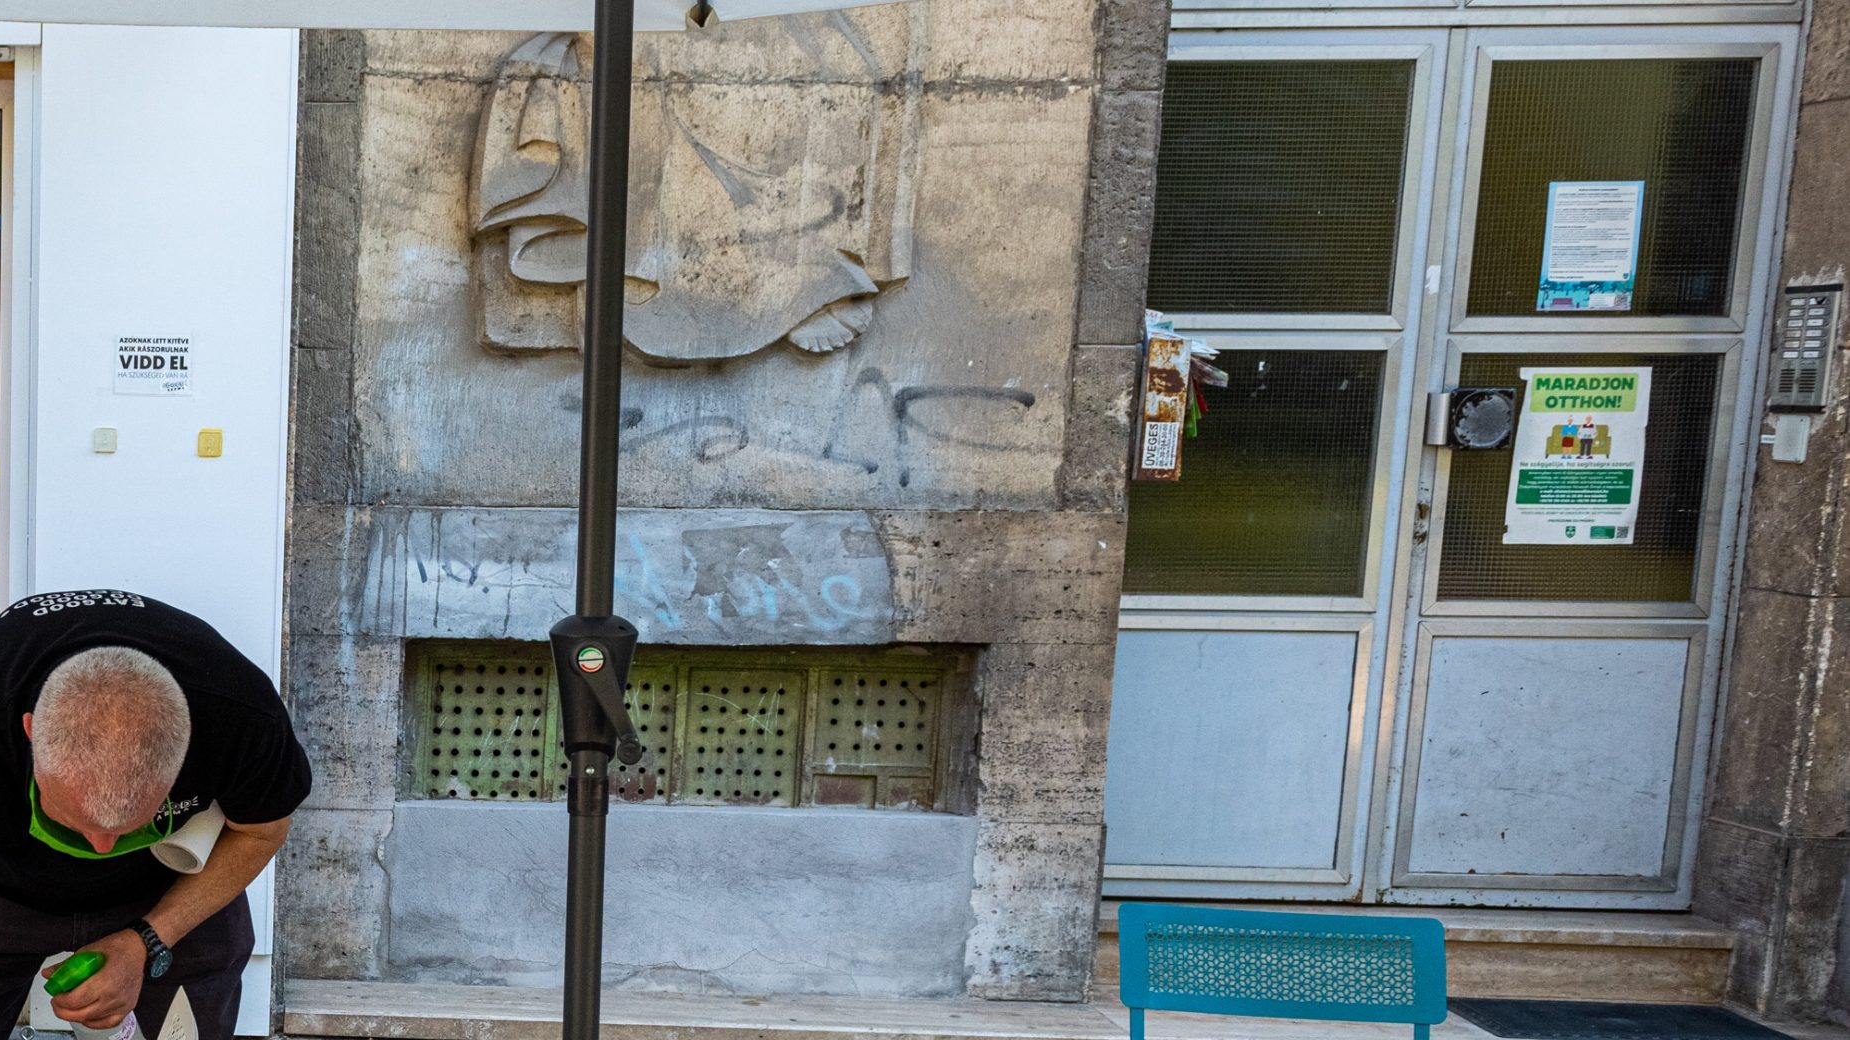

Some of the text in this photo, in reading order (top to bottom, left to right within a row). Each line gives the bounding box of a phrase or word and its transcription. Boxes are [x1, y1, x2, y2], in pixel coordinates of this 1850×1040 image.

[167, 337, 189, 345] KITÉVE
[137, 345, 189, 353] RÁSZORULNAK
[119, 354, 188, 370] VIDD EL
[1535, 376, 1636, 391] MARADJON
[1544, 395, 1623, 409] OTTHON!
[1145, 423, 1159, 467] ÜVEGES
[32, 598, 145, 616] EAT GOOD
[39, 594, 103, 607] GOOD
